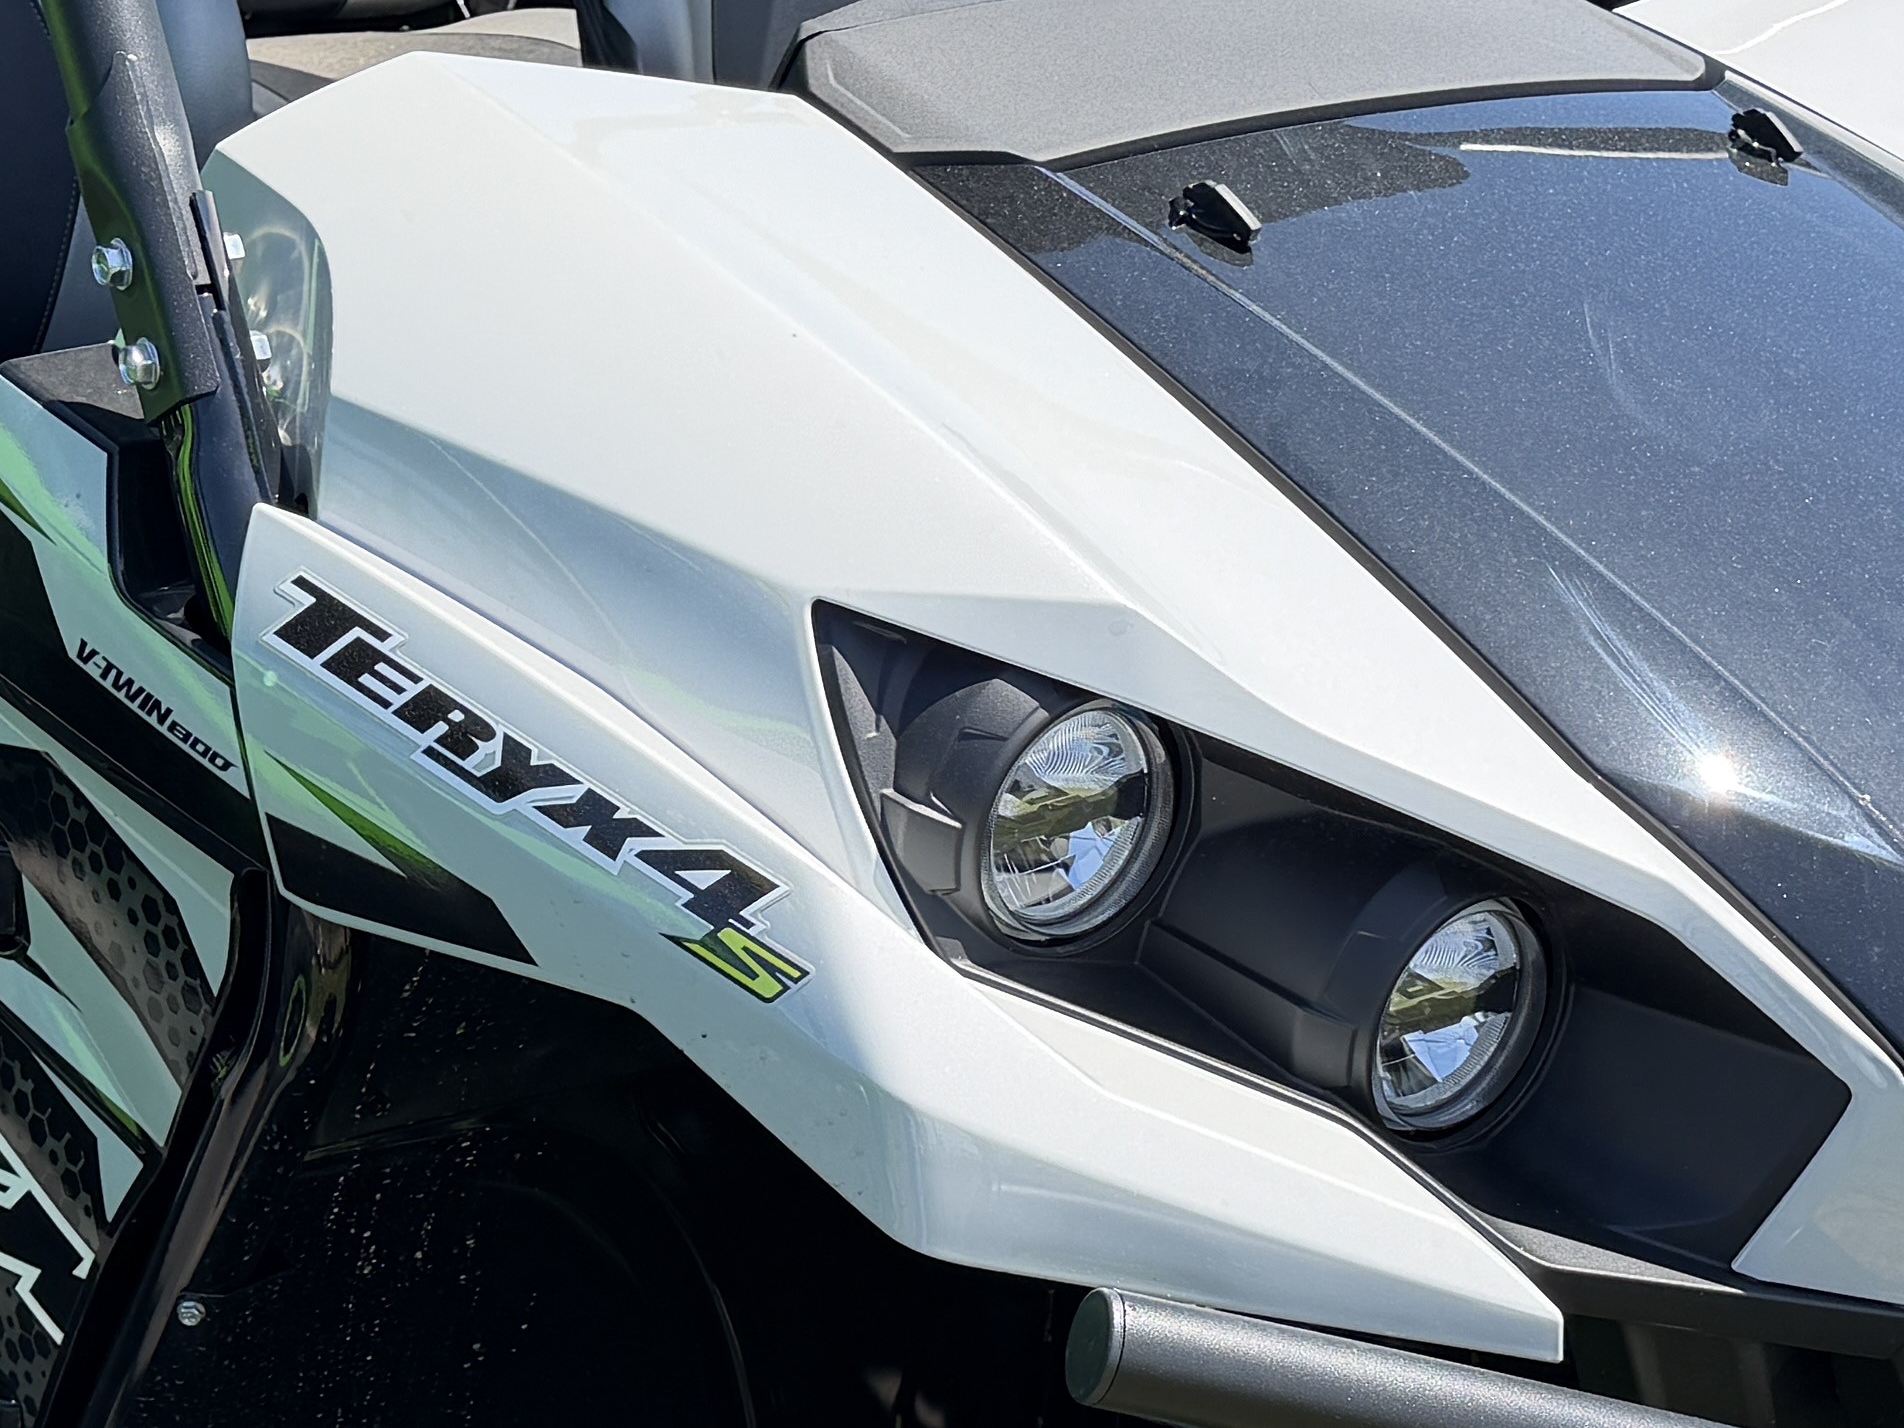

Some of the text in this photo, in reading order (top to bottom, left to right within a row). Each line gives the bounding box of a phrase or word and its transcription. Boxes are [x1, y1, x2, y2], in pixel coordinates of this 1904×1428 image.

[74, 637, 239, 774] V-TWIN 800
[270, 572, 786, 932] TERYX4
